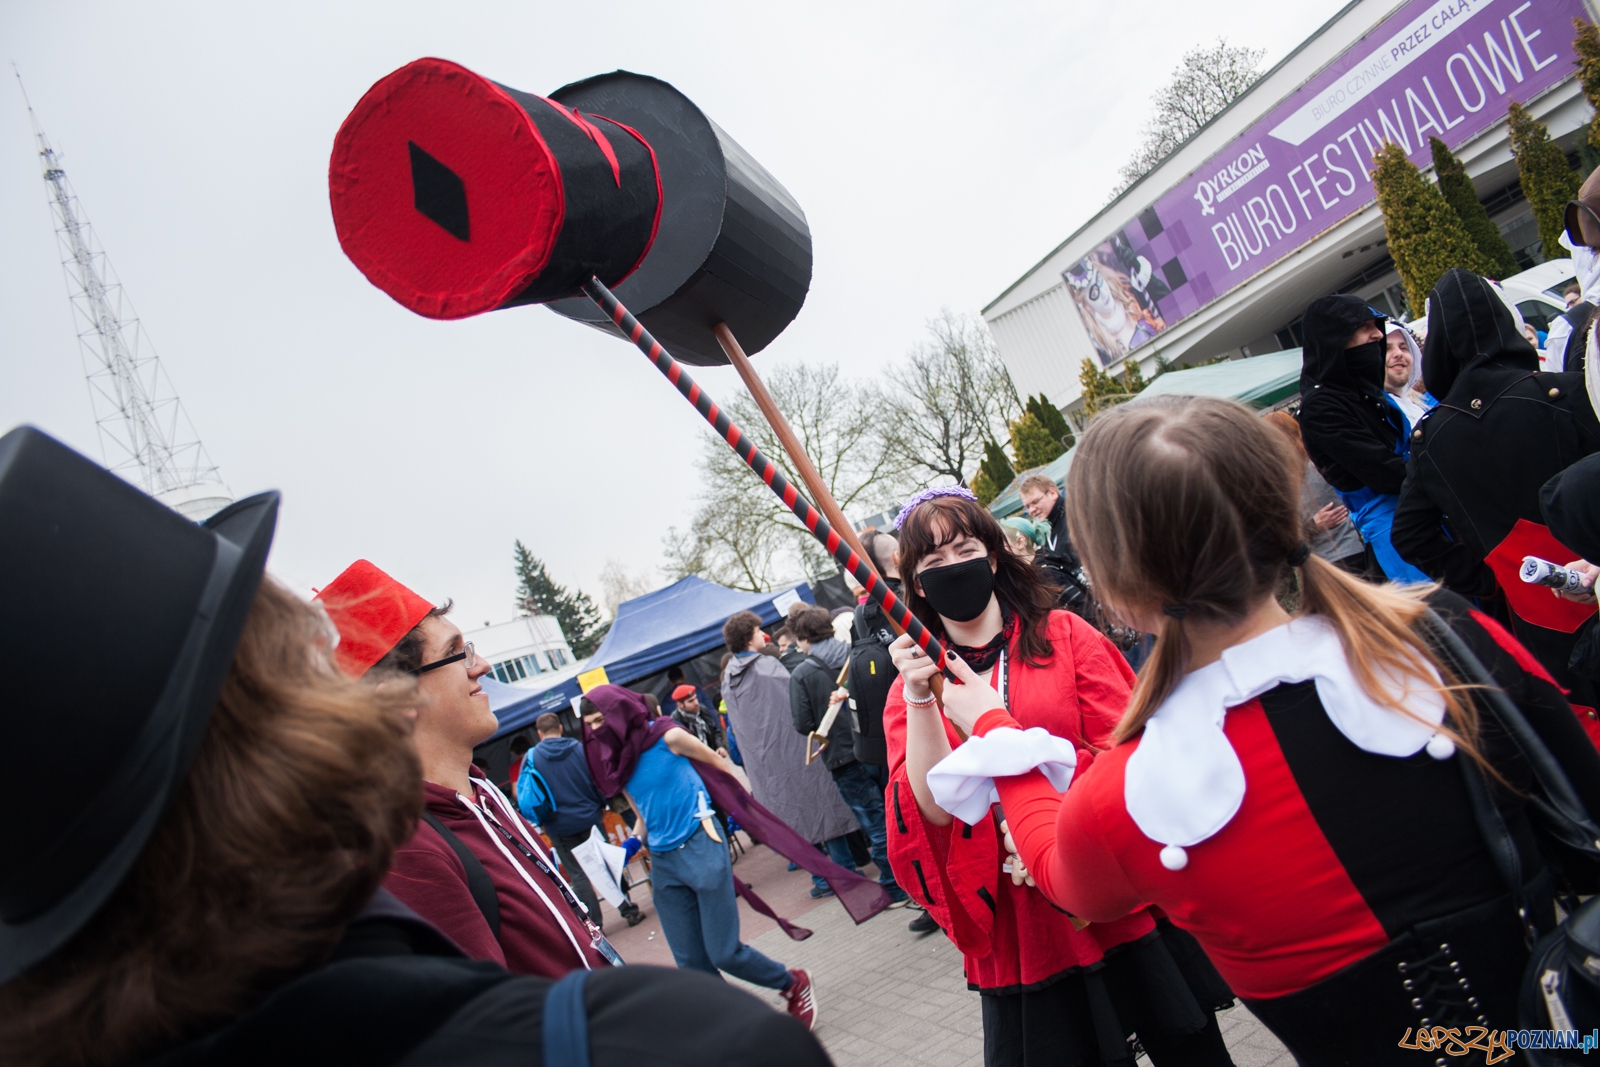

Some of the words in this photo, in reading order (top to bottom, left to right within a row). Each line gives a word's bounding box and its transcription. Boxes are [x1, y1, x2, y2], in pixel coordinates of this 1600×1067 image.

[1311, 89, 1346, 121] BIURO
[1346, 54, 1392, 95] CZYNNE
[1390, 24, 1432, 61] PRZEZ
[1431, 0, 1471, 30] CAŁĄ
[1194, 143, 1266, 216] PYRKON
[1211, 184, 1297, 271] BIURO
[1287, 1, 1558, 221] FESTIWALOWE
